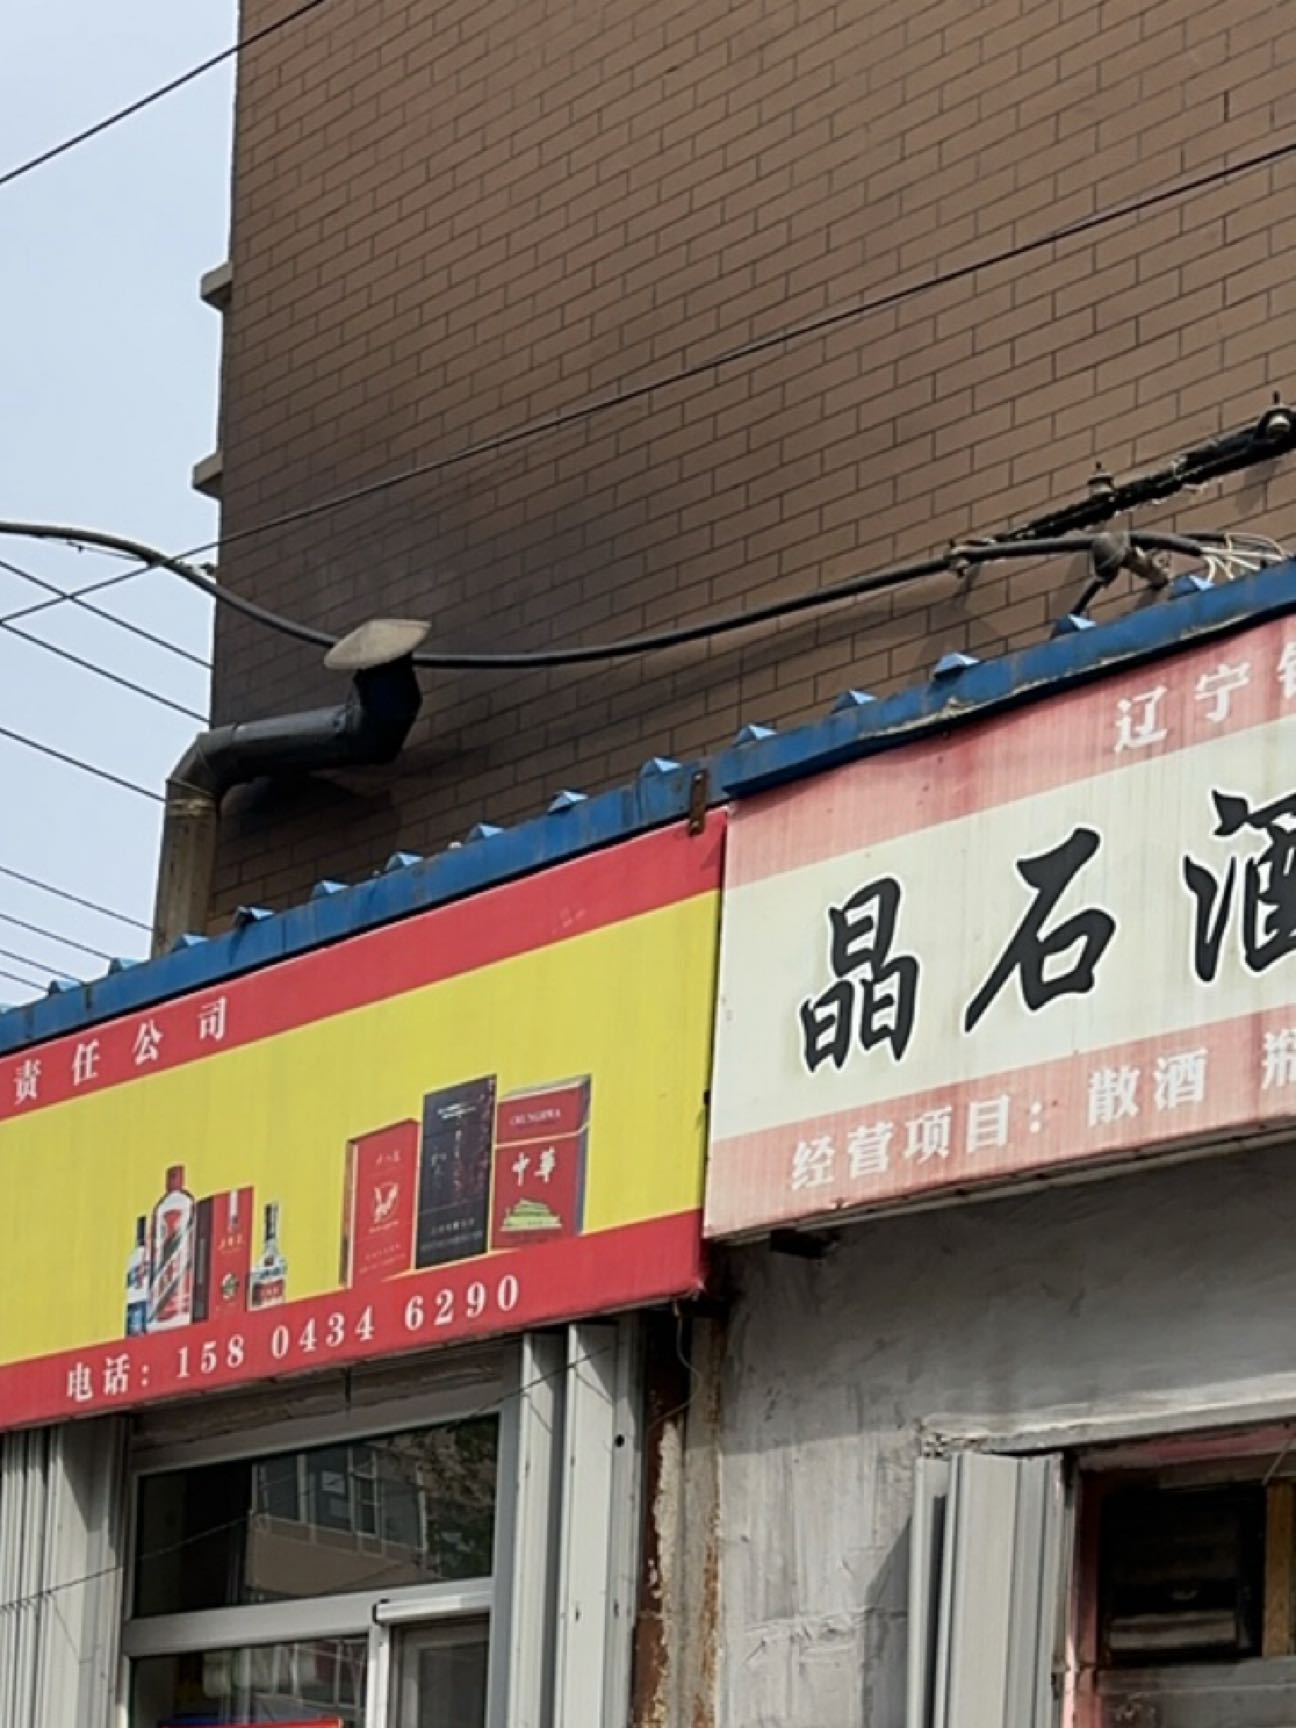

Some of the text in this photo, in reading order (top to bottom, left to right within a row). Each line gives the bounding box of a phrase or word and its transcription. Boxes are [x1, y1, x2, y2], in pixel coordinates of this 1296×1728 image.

[66, 1274, 521, 1402] 电话： 158 0434 6290
